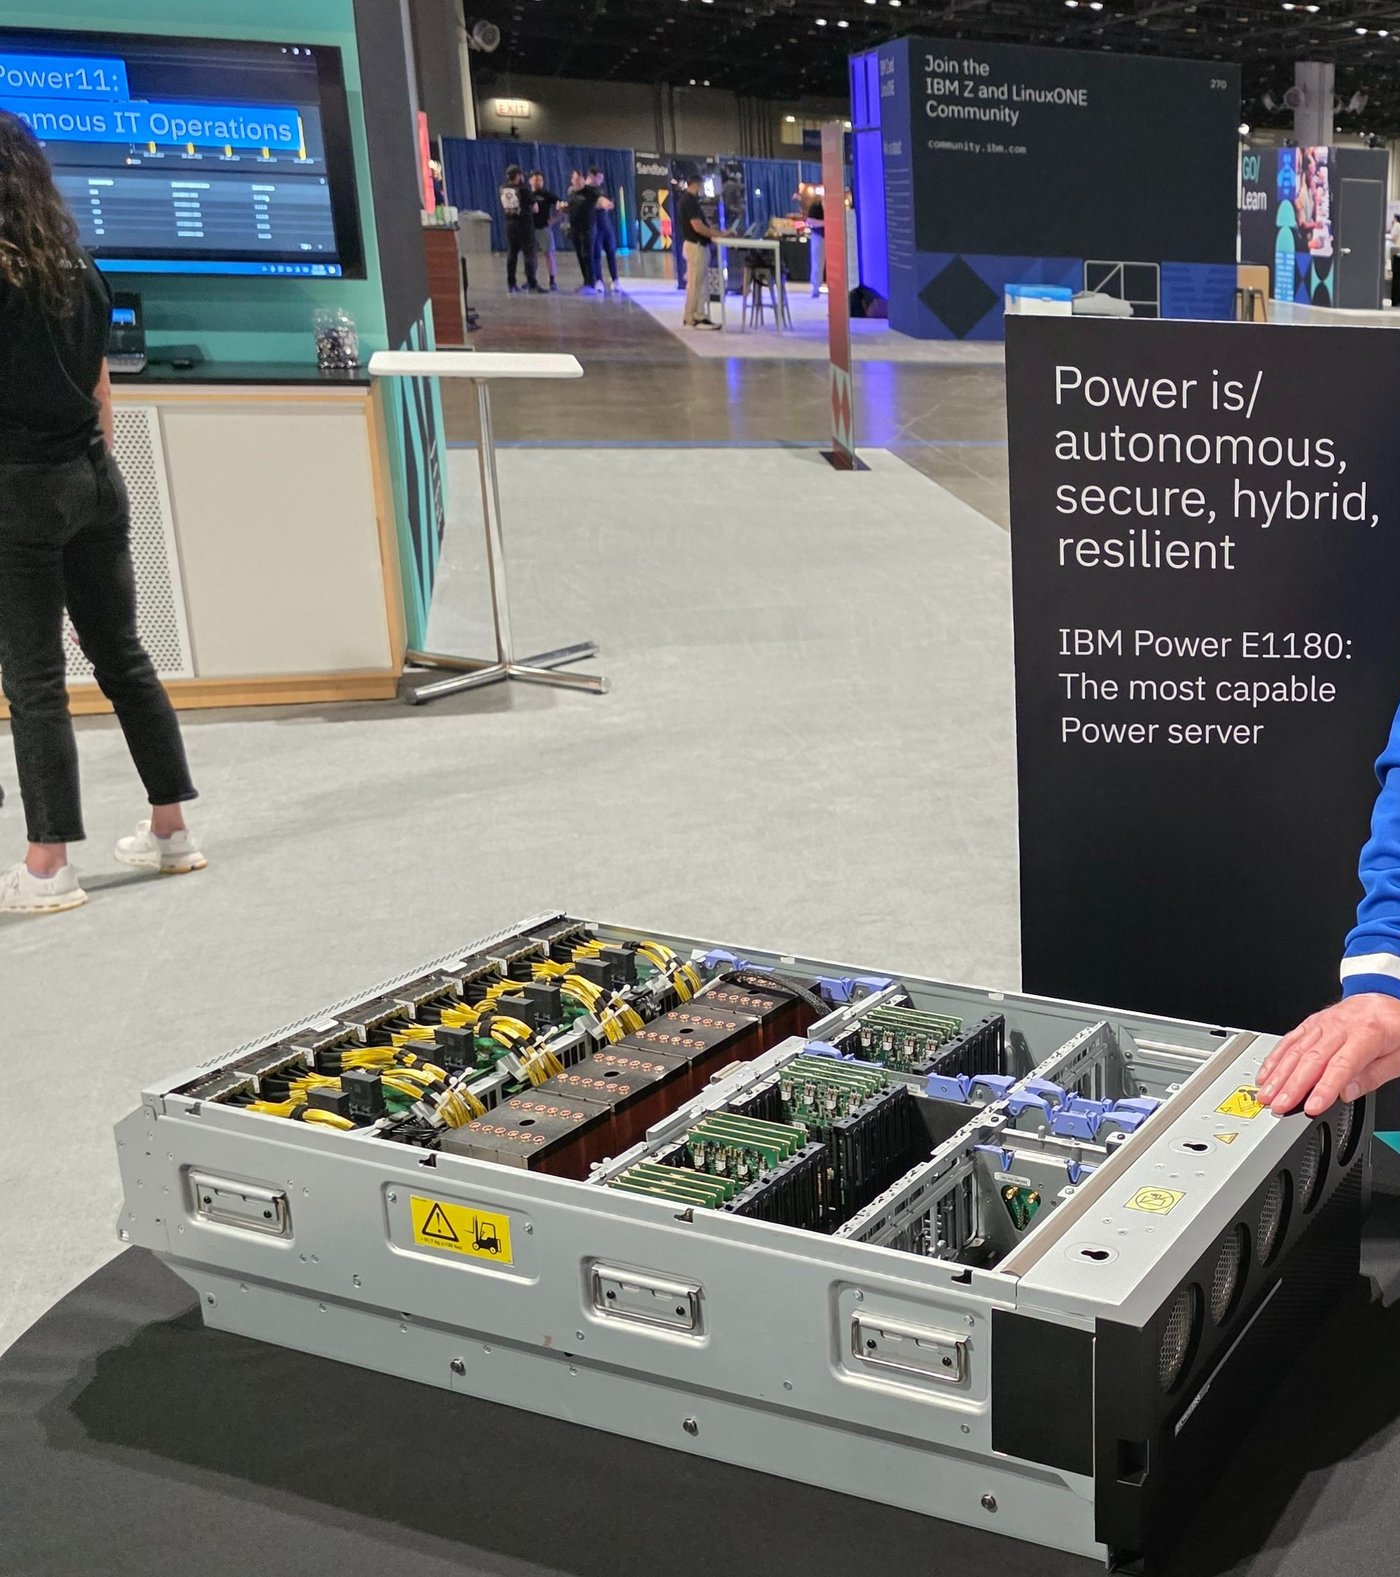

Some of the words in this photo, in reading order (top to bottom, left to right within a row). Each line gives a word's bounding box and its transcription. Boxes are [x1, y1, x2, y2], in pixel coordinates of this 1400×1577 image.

[925, 55, 958, 74] Join
[963, 58, 990, 76] the
[926, 78, 959, 96] IBM
[963, 81, 975, 98] Z
[978, 83, 1008, 100] and
[1012, 84, 1088, 107] LinuxONE
[1210, 79, 1227, 90] 270
[113, 111, 141, 134] IT
[150, 113, 292, 141] Operations
[926, 100, 1019, 127] Community
[928, 139, 1027, 154] community.ibm.com
[1242, 155, 1260, 183] GO/
[1242, 187, 1267, 210] Learn
[1054, 365, 1197, 409] Power
[1211, 369, 1264, 419] is/
[1054, 425, 1348, 475] autonomous,
[1055, 482, 1217, 524] secure,
[1233, 479, 1380, 529] hybrid,
[1058, 529, 1236, 570] resilient
[1058, 628, 1123, 657] IBM
[1134, 630, 1232, 658] Power
[1242, 632, 1353, 661] E1180:
[1058, 673, 1119, 701] The
[1129, 676, 1206, 702] most
[1215, 675, 1337, 708] capable
[1062, 717, 1159, 744] Power
[1168, 721, 1264, 745] server
